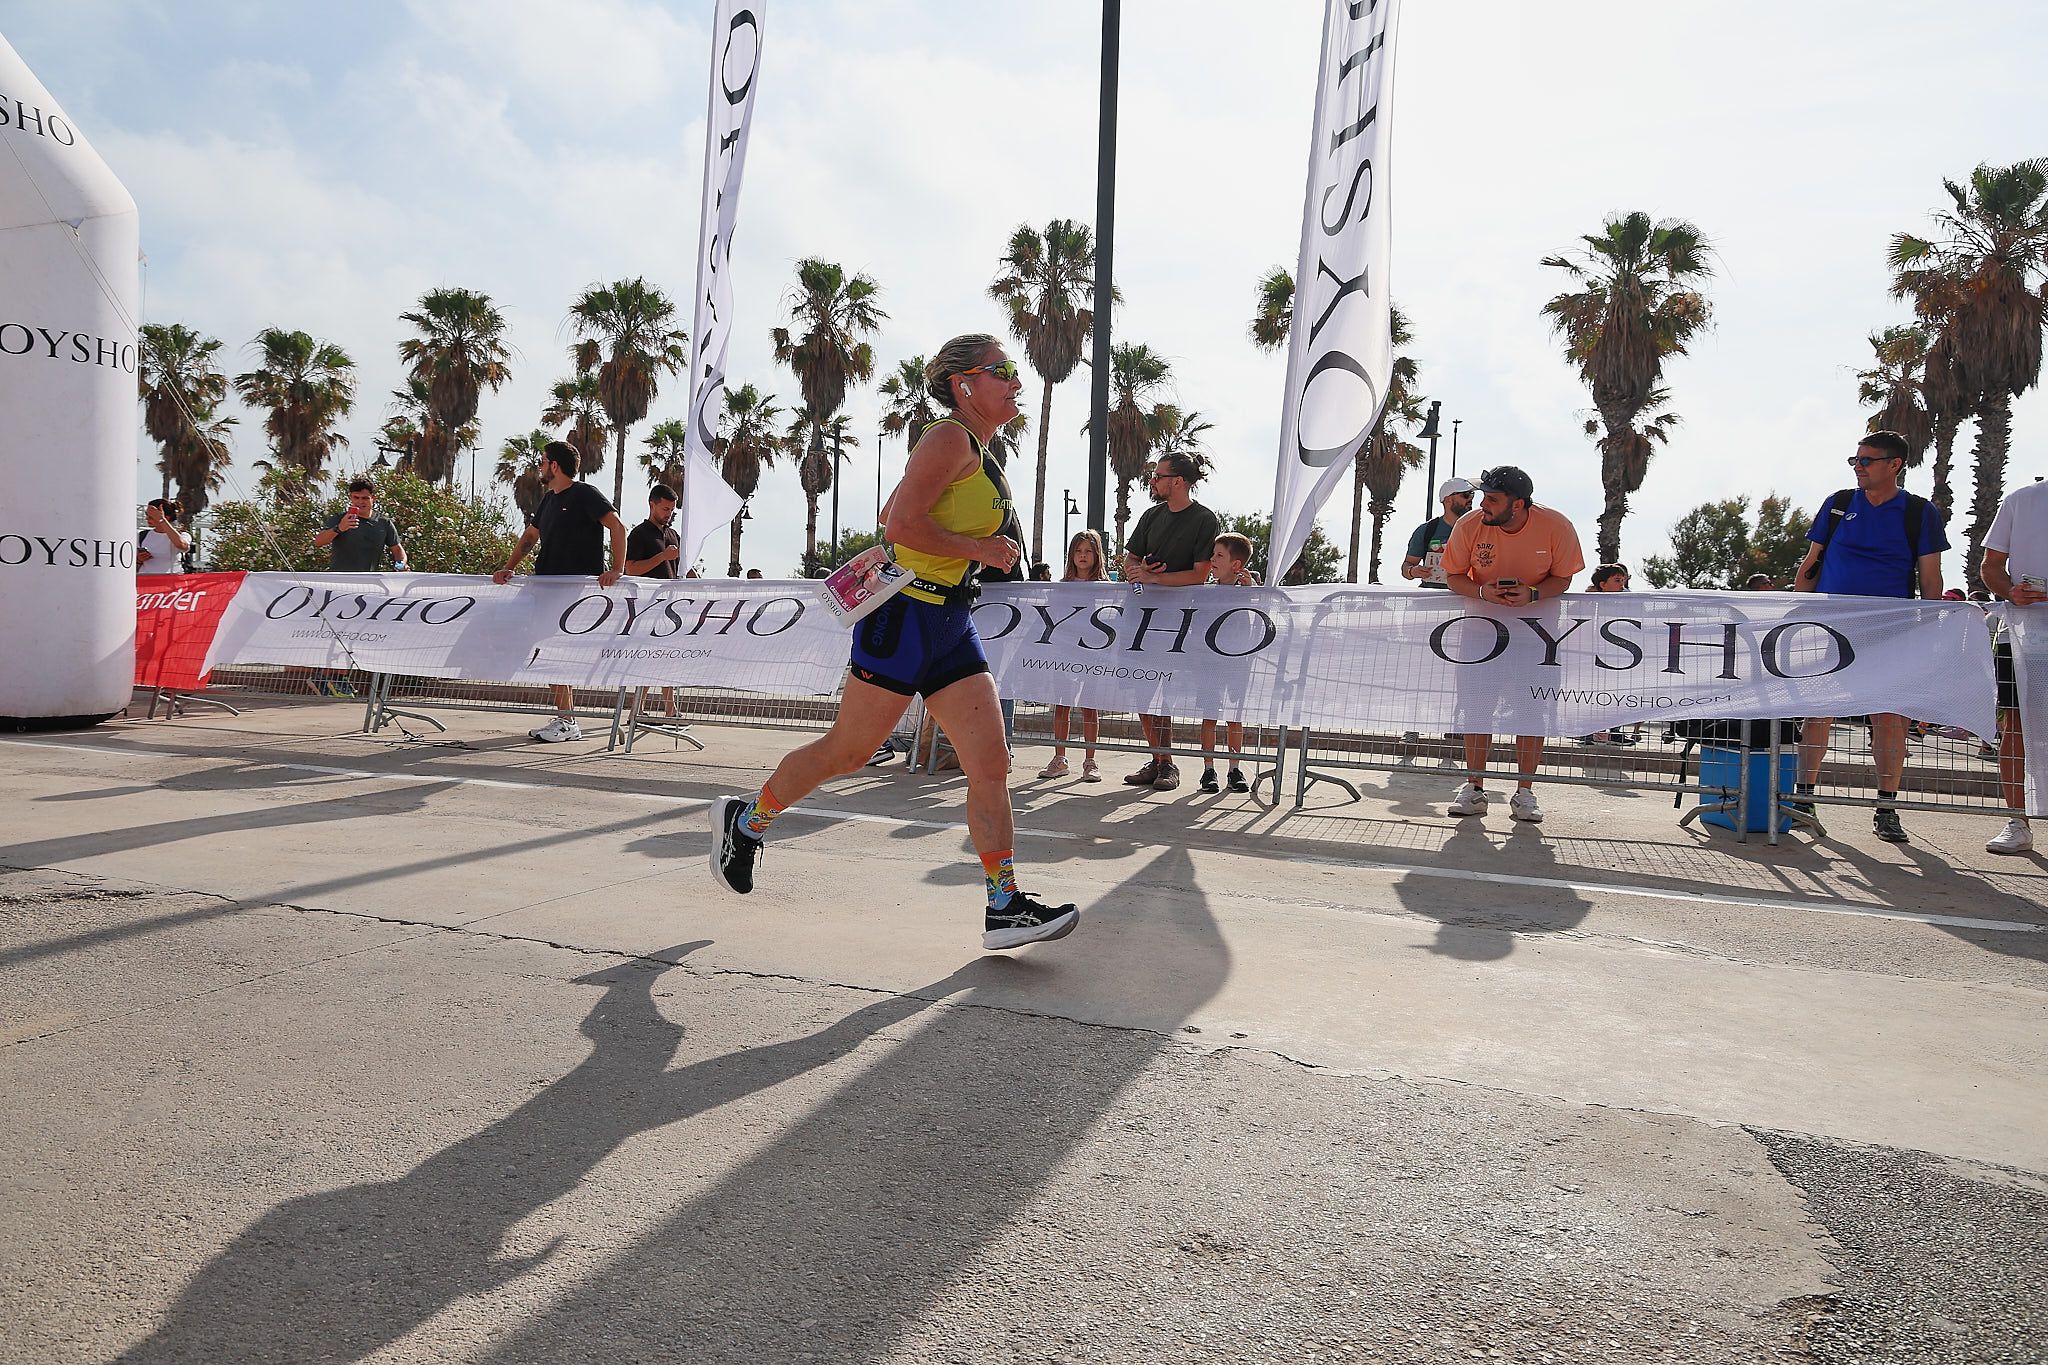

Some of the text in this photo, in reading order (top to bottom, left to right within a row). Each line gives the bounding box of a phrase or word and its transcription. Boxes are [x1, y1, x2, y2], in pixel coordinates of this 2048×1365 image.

[0, 323, 136, 374] OYSHO
[0, 534, 133, 569] OYSHO
[265, 586, 476, 625] OYSHO
[559, 594, 806, 637] OYSHO
[821, 592, 840, 616] OYSHO
[291, 629, 389, 643] WWW.OYSHO.COM
[970, 602, 1277, 657] OYSHO
[600, 649, 712, 660] WWW.OYSHO.COM
[1429, 615, 1855, 680] OYSHO
[1022, 658, 1173, 683] WWW.OYSHO.COM
[1529, 685, 1730, 709] WWW.OYSHO.COM
